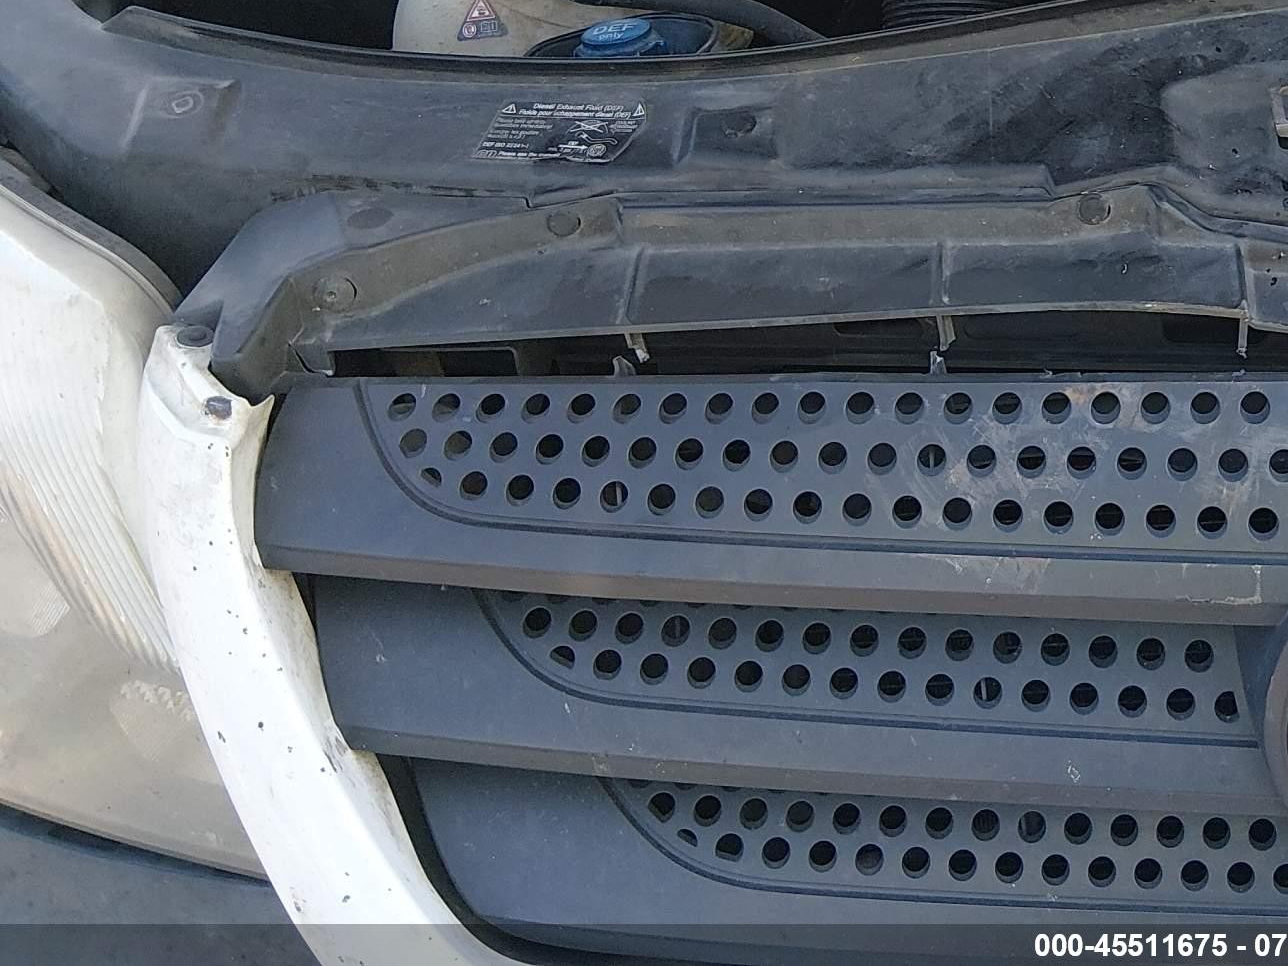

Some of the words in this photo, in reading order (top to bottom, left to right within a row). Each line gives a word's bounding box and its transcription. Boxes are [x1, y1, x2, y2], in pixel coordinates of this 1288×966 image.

[594, 22, 637, 35] DEF
[599, 31, 625, 41] only
[533, 102, 556, 110] Diesel
[556, 103, 585, 111] Exhaust
